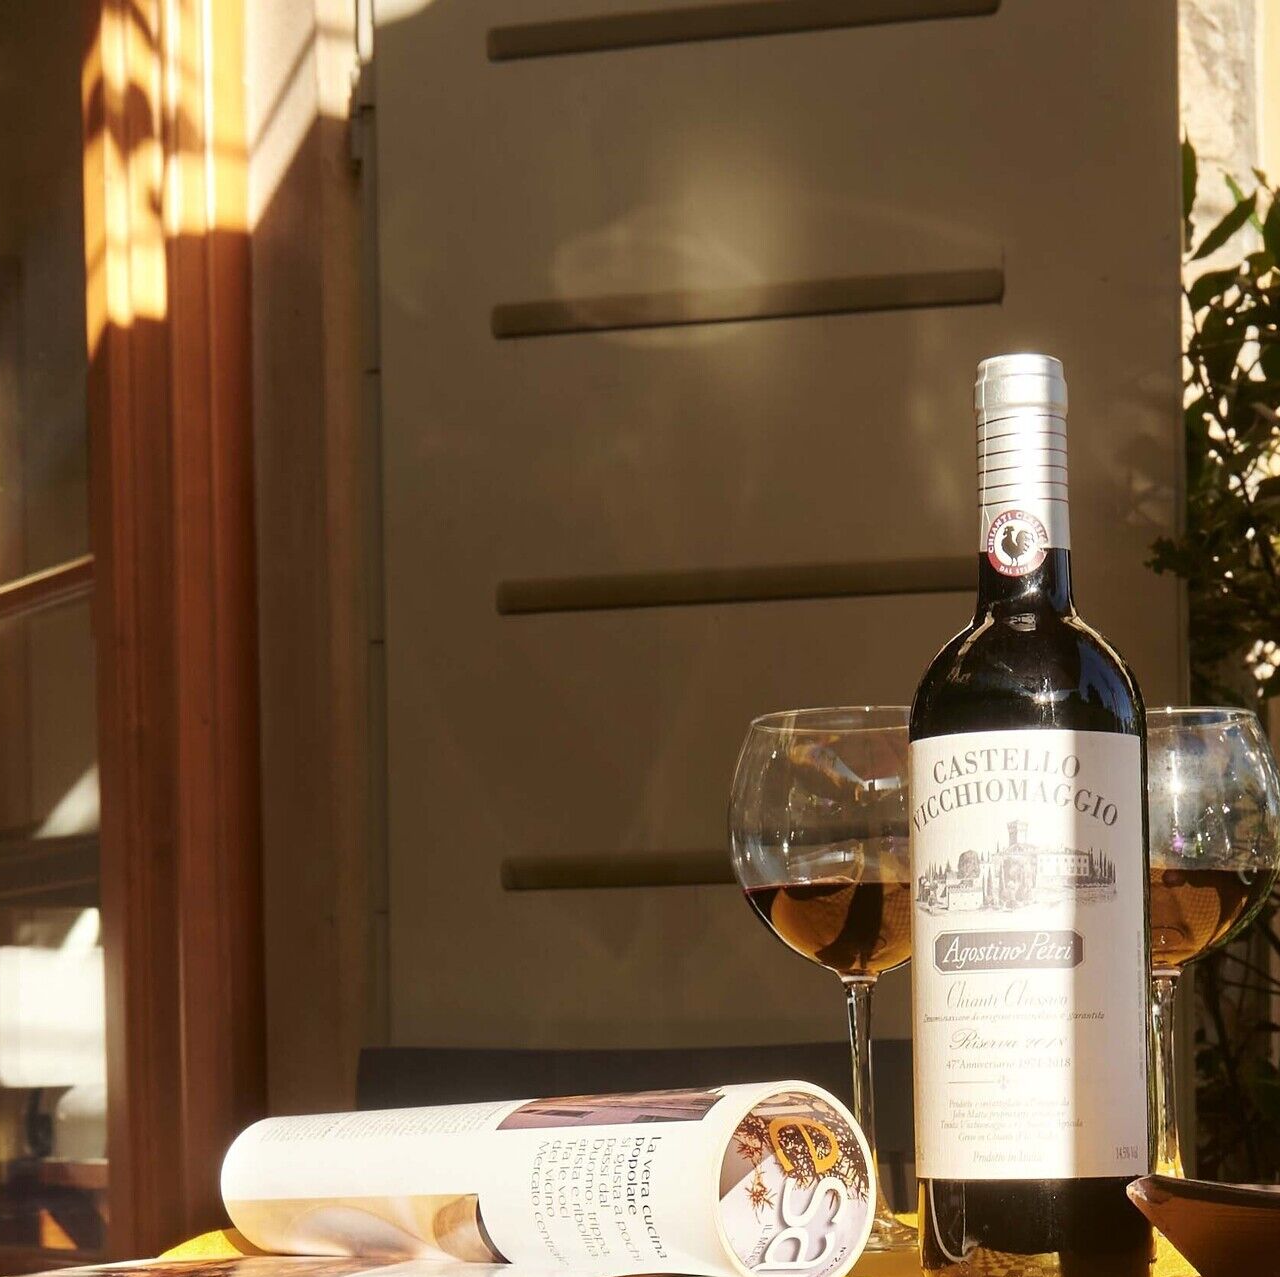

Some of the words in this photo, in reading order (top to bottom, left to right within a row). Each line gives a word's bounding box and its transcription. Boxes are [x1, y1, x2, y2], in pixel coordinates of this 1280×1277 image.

[988, 513, 1012, 553] CHIANTI
[999, 564, 1013, 574] DAL
[932, 747, 1081, 785] CASTELLO
[913, 778, 1119, 832] VICCHIOMAGGIO
[942, 935, 1024, 969] Agostino
[1025, 932, 1074, 962] Petri
[946, 979, 998, 1009] Chianti
[949, 1028, 1018, 1050] Riserva
[550, 1139, 562, 1164] del
[561, 1141, 577, 1161] Tra
[572, 1138, 589, 1181] arista
[598, 1138, 617, 1177] passi
[646, 1136, 662, 1154] La
[530, 1140, 551, 1207] Mercato
[559, 1165, 571, 1181] le
[570, 1185, 581, 1198] e
[612, 1152, 626, 1201] gusta
[626, 1136, 646, 1216] popolare
[640, 1158, 653, 1199] vera
[543, 1168, 556, 1218] vicino
[557, 1185, 571, 1219] voci
[599, 1181, 611, 1209] dal
[613, 1205, 623, 1216] a
[615, 1220, 645, 1264] pochi
[642, 1204, 668, 1259] cucina
